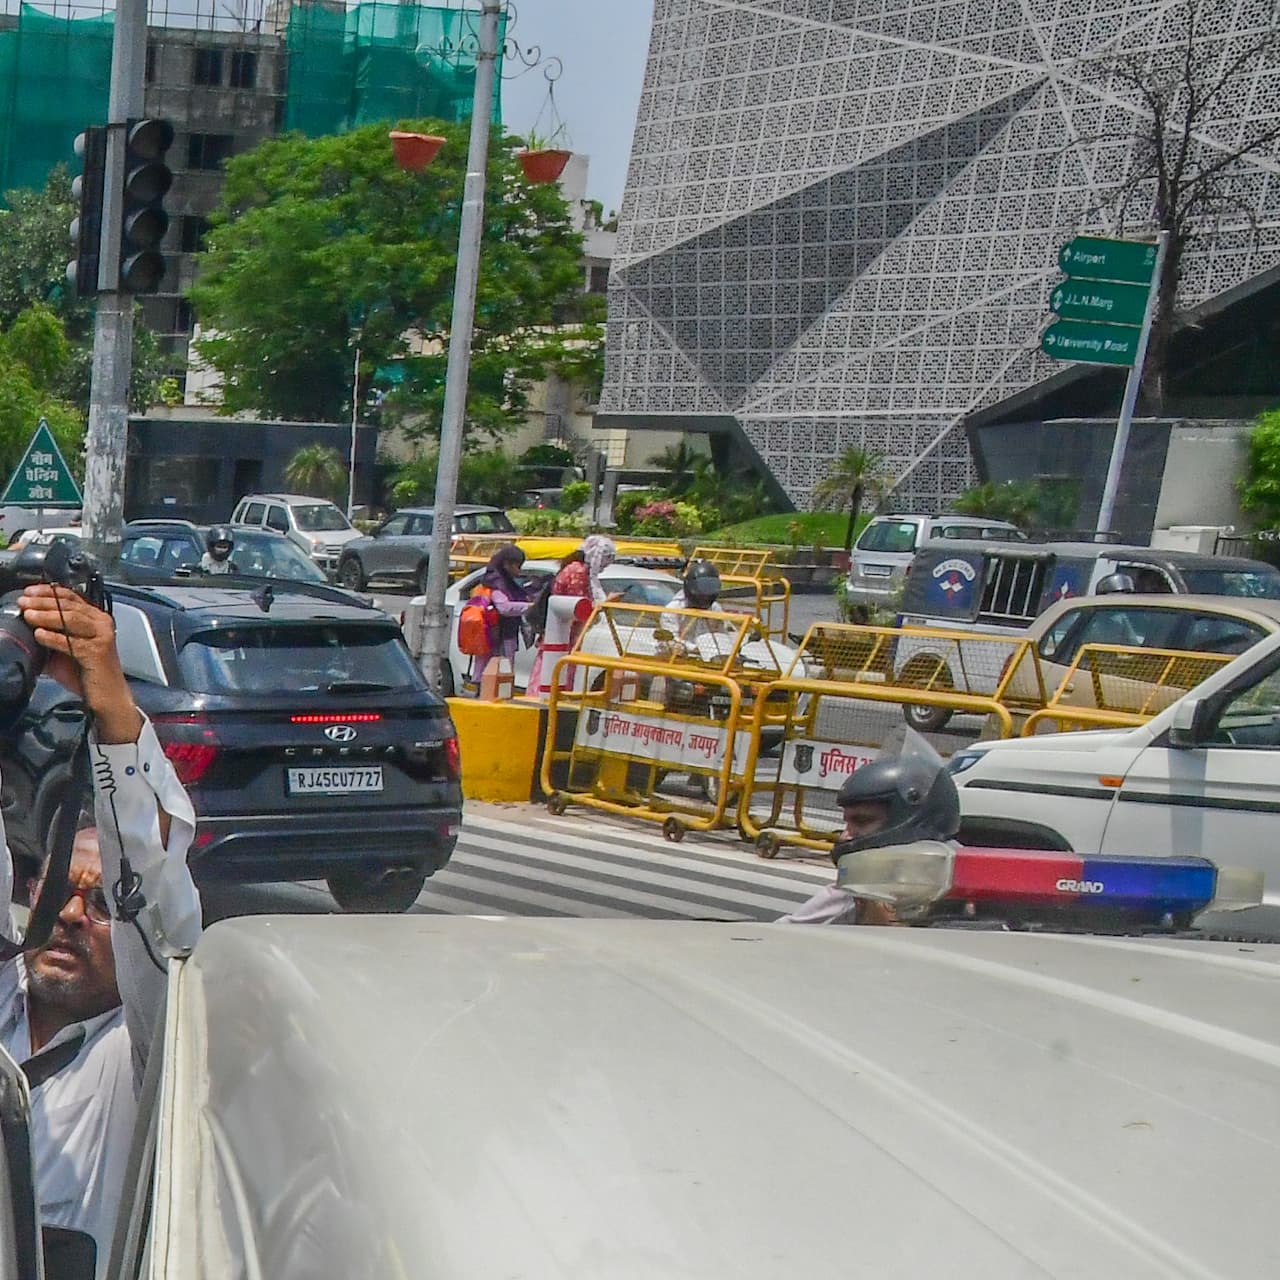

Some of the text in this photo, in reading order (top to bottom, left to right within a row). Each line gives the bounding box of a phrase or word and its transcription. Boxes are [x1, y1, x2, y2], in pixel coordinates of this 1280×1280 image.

[1073, 251, 1106, 265] Airport
[1056, 336, 1129, 352] University Road
[602, 714, 631, 738] पुलिस
[687, 733, 720, 759] जयपुर
[285, 745, 396, 756] CRETA
[819, 748, 858, 778] पुलिस
[298, 770, 382, 789] RJ45CU7727
[1055, 879, 1104, 894] GRAND
